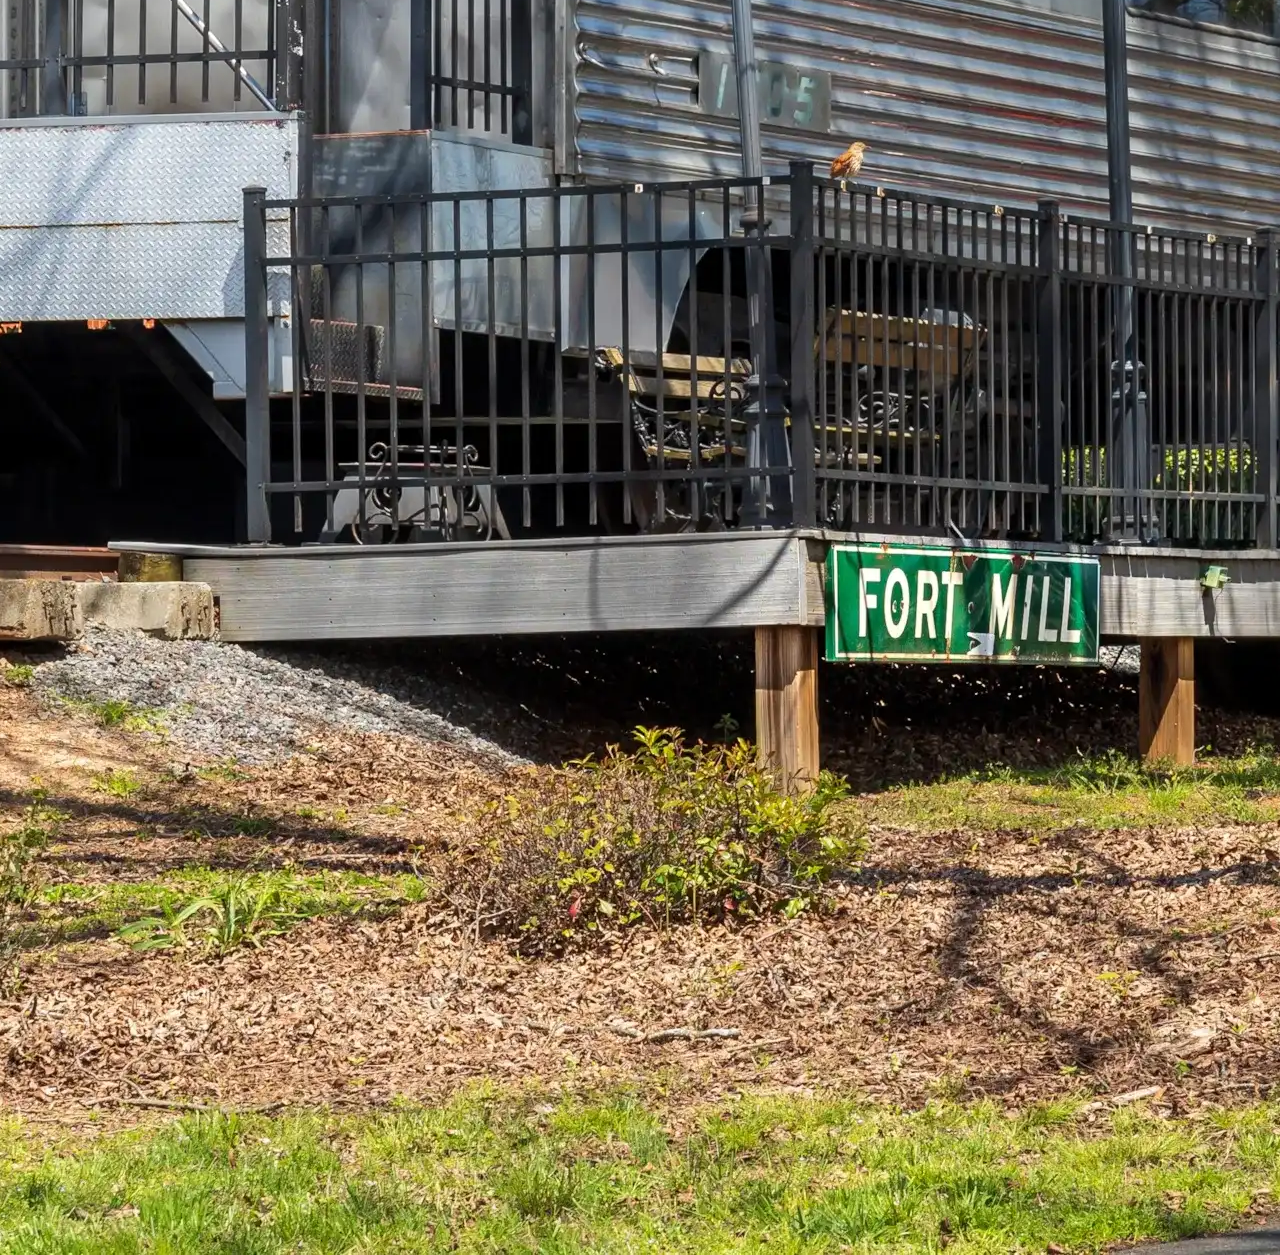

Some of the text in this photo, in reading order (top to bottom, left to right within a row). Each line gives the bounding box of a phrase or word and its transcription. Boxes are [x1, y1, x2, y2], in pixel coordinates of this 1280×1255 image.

[716, 61, 817, 126] 105
[858, 567, 1081, 643] FORT MILL
